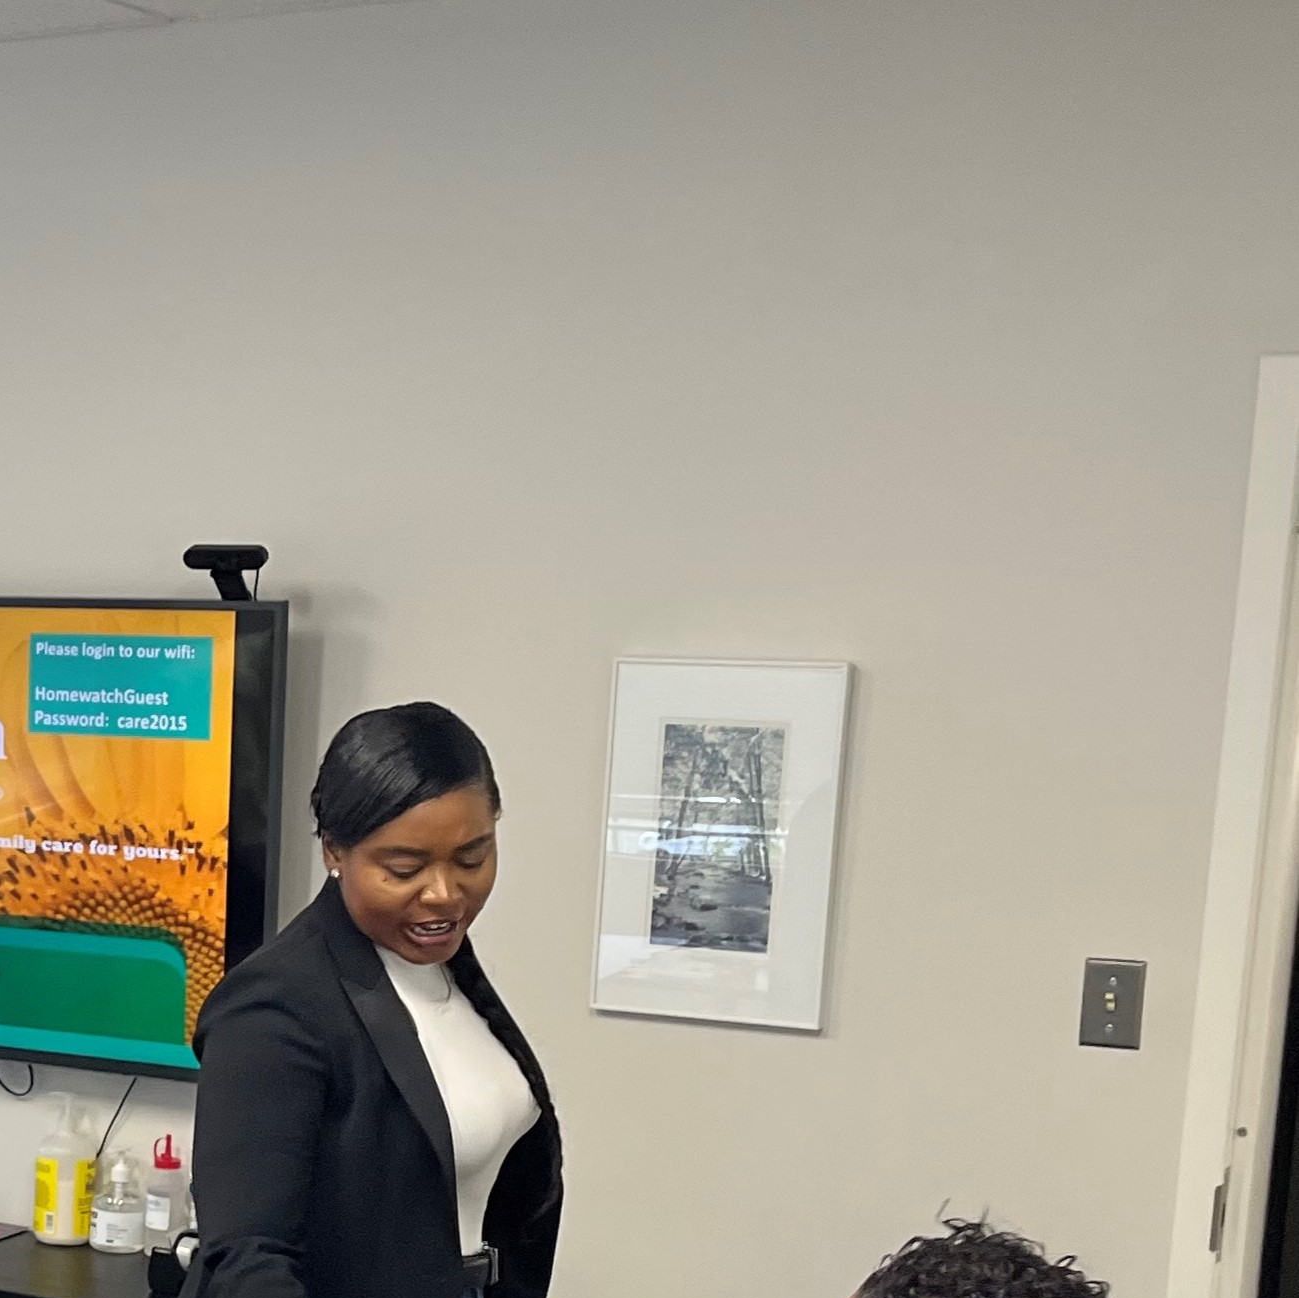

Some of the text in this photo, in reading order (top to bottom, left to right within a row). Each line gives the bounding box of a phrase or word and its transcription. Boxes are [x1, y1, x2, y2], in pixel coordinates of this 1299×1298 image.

[35, 642, 196, 660] Please login to our wifi:
[34, 686, 169, 705] HomewatchGuest
[34, 710, 187, 731] Password: care2015
[41, 839, 84, 855] care
[89, 840, 118, 856] for
